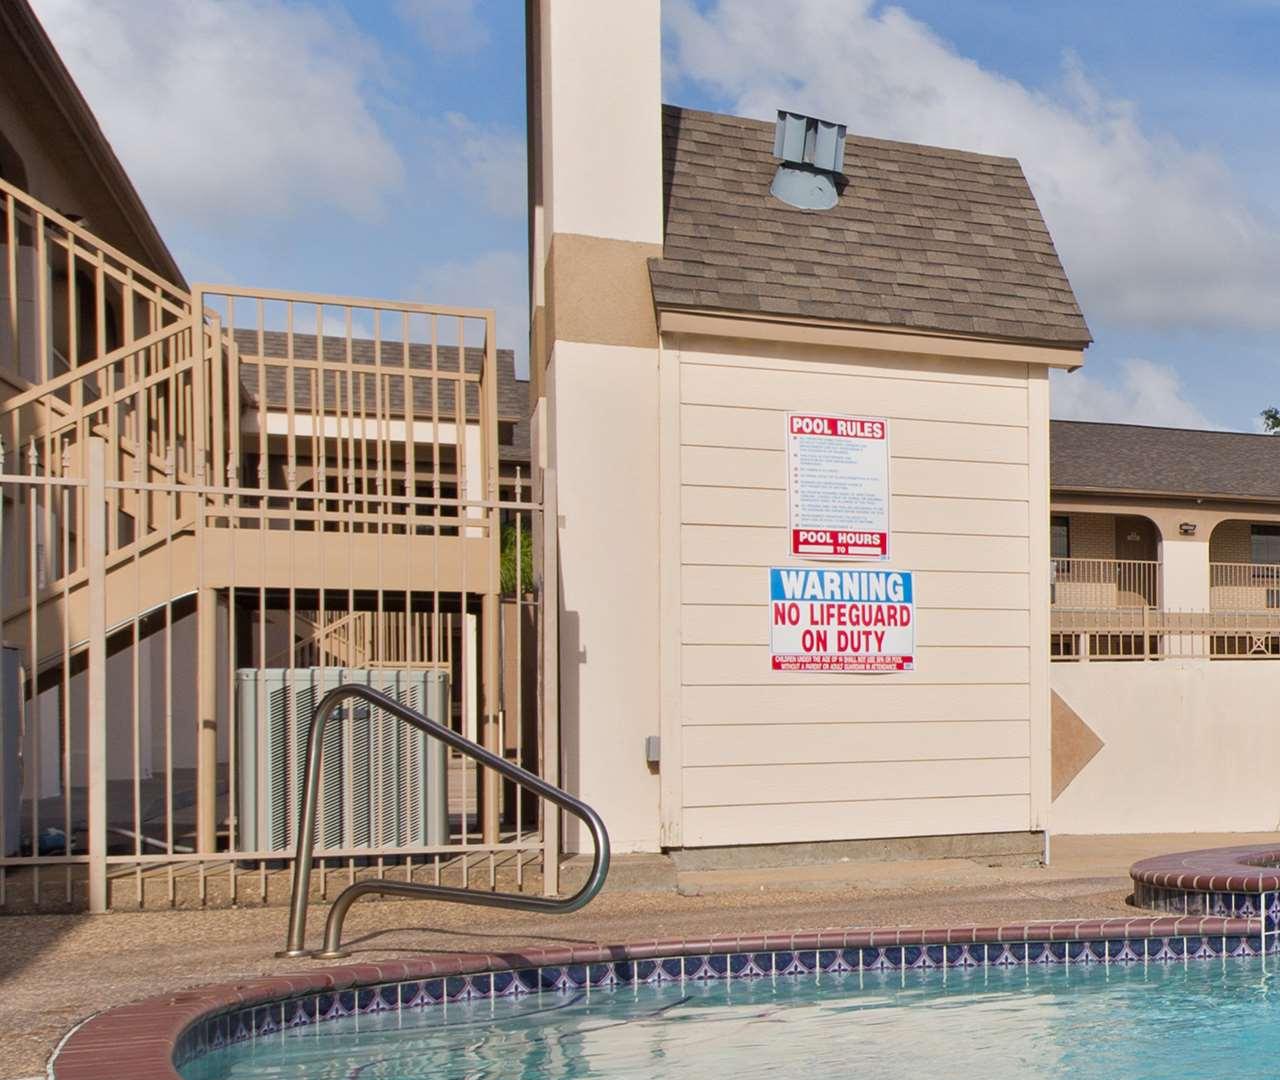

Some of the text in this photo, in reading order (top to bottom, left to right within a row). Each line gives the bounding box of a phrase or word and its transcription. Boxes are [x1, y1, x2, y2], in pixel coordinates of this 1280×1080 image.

[792, 417, 883, 438] POOL RULES
[799, 531, 881, 545] POOL HOURS
[836, 546, 846, 554] TO
[780, 571, 904, 602] WARNING
[774, 602, 911, 627] NO LIFEGUARD
[802, 629, 886, 653] ON DUTY
